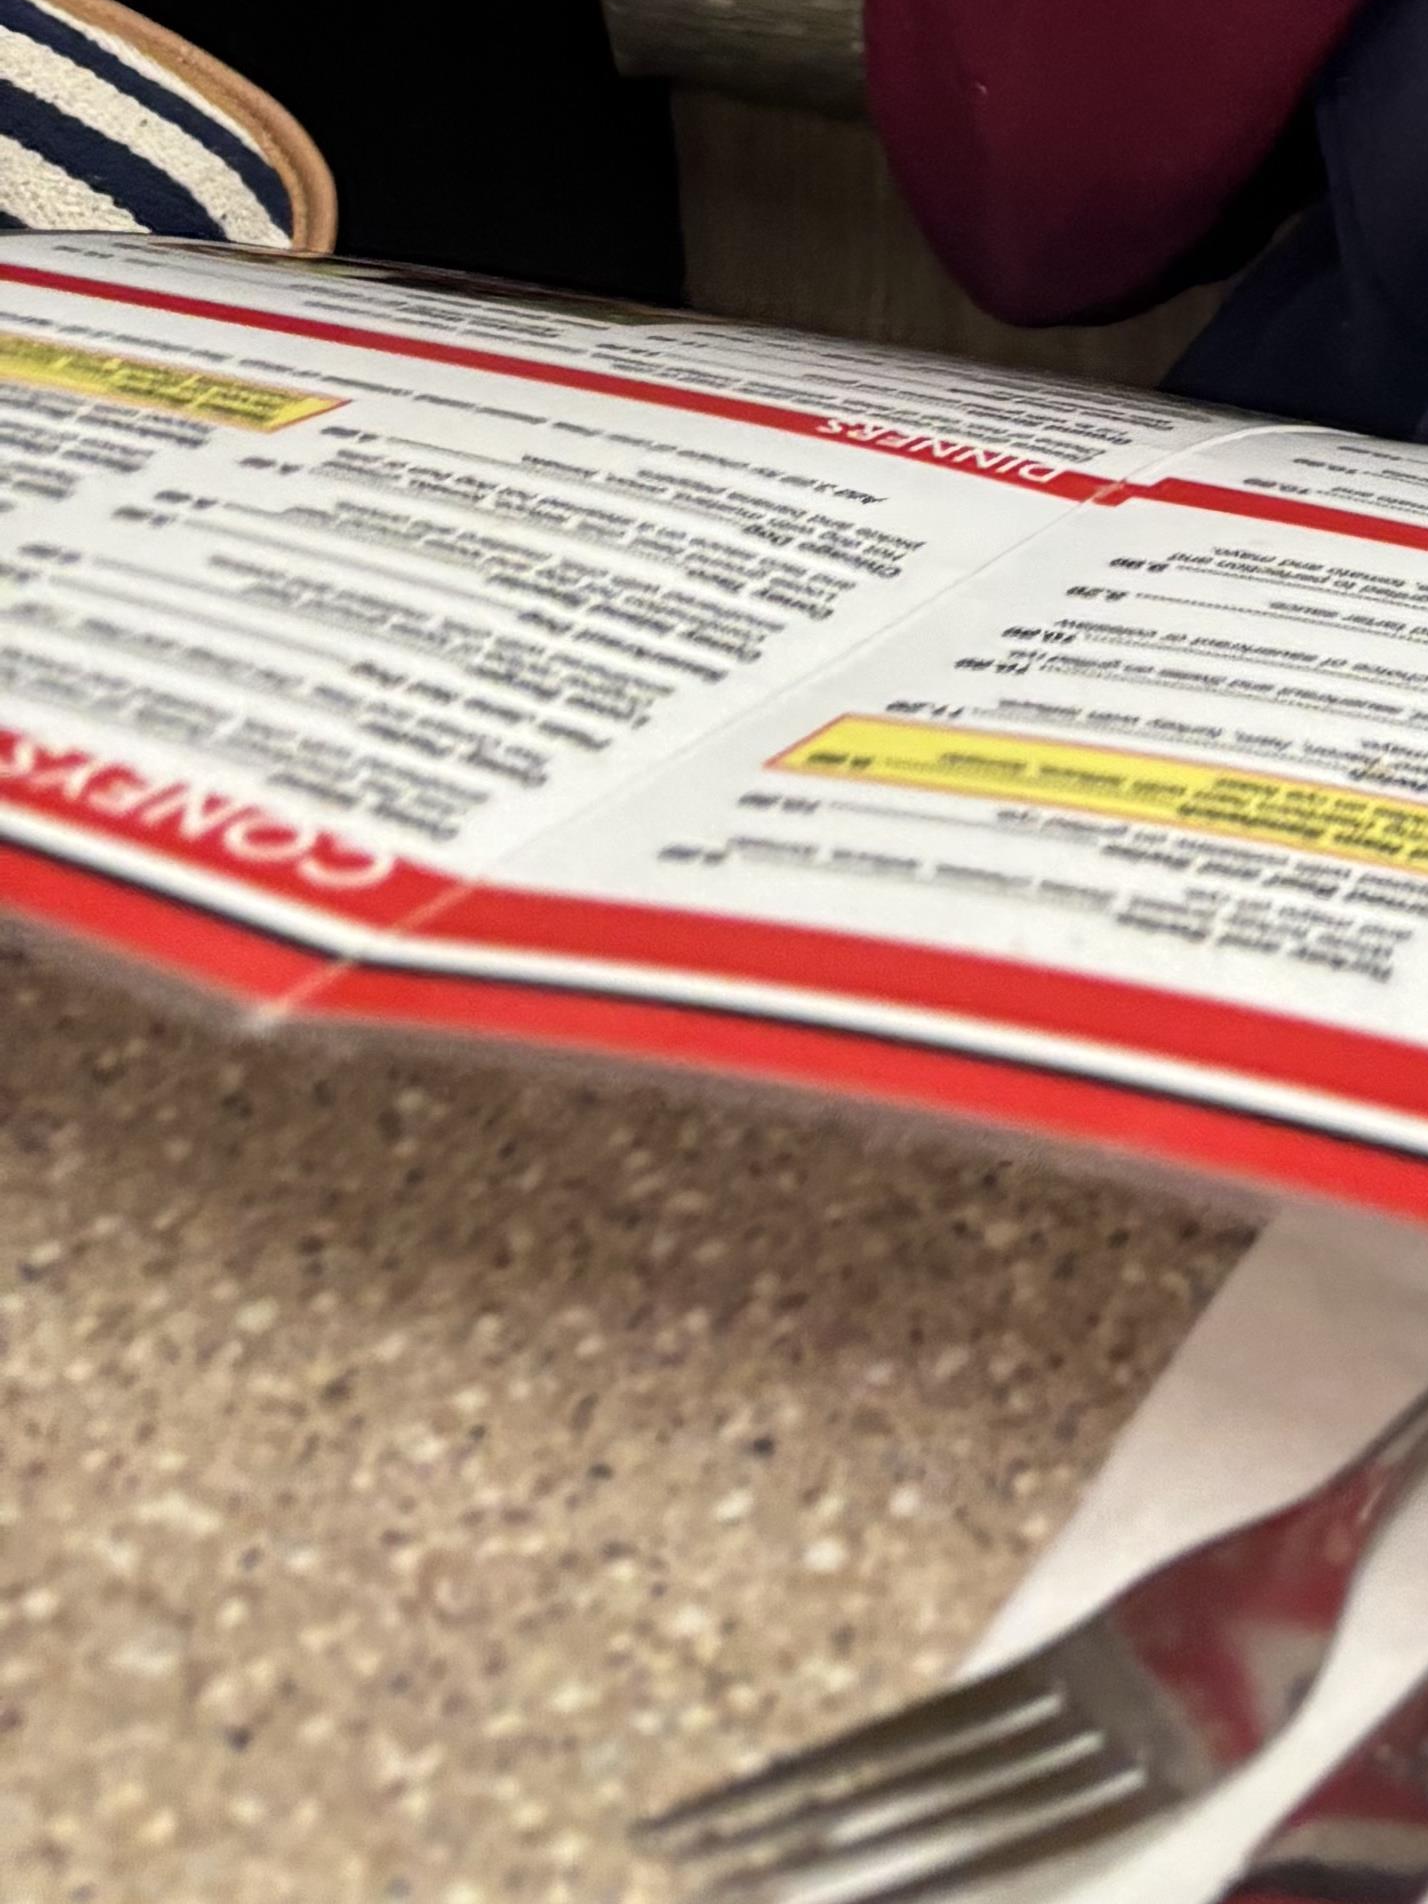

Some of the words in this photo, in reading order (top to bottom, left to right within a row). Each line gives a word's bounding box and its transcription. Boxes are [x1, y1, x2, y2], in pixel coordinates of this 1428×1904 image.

[815, 416, 1061, 485] DINNERS
[1166, 552, 1214, 565] and
[1279, 558, 1325, 575] and
[1328, 567, 1406, 590] tomato
[1334, 579, 1356, 593] to
